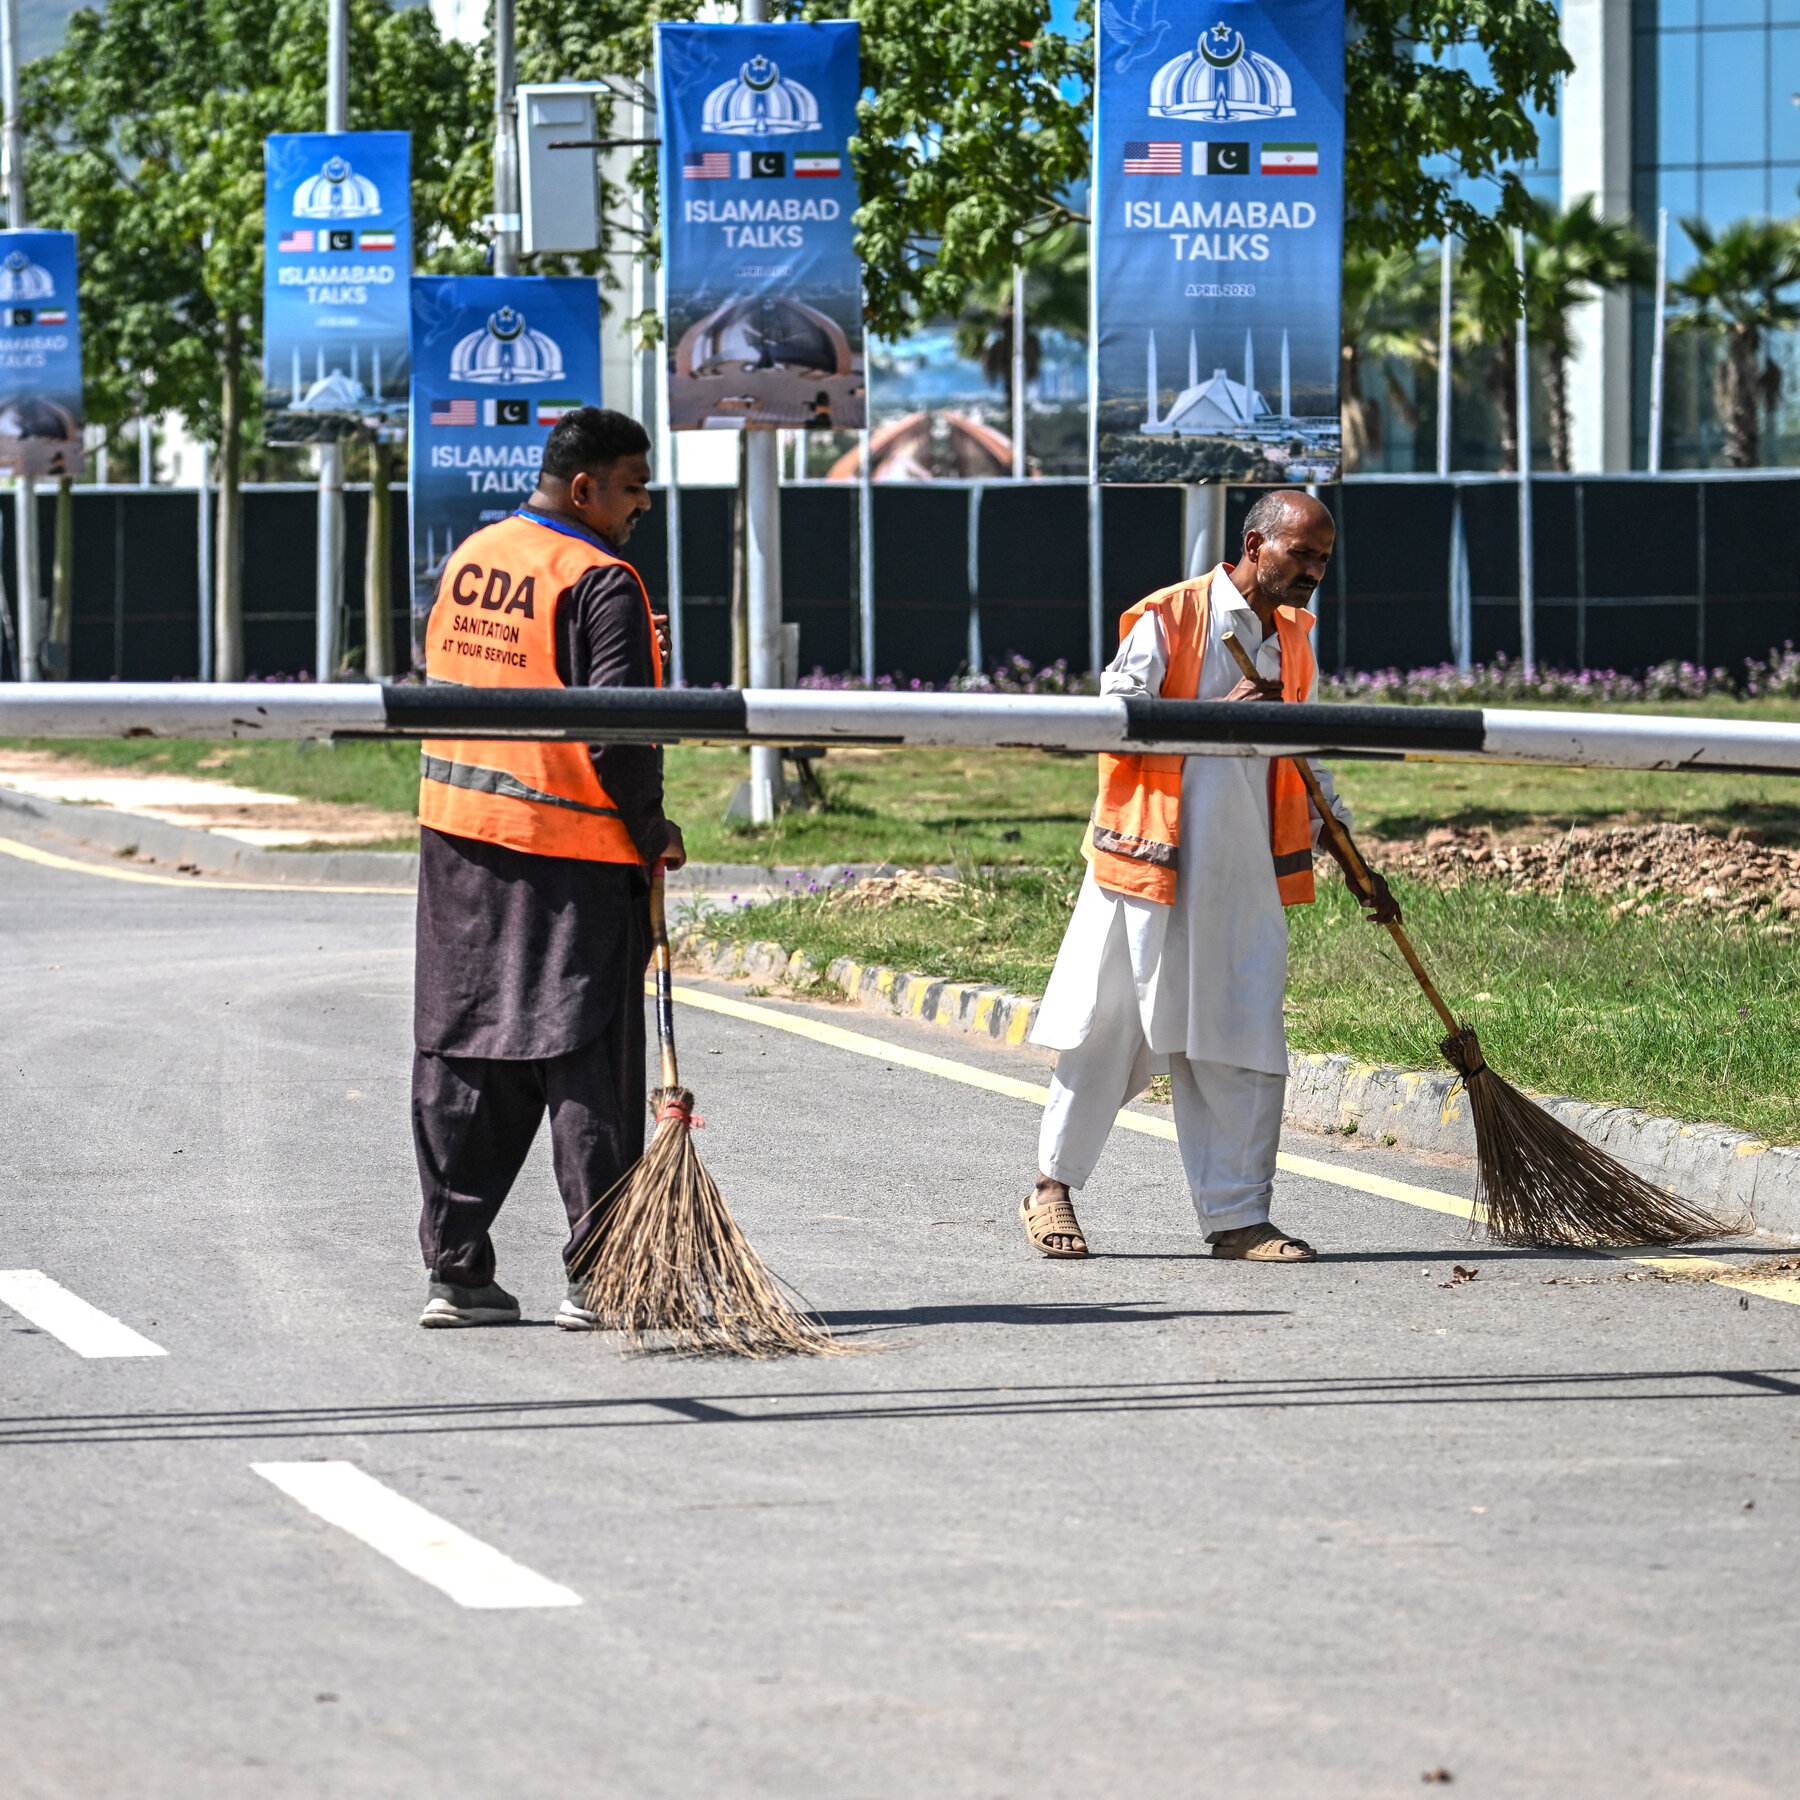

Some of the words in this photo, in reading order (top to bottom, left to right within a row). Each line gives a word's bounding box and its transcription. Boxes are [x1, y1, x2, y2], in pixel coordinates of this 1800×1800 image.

[685, 199, 840, 223] ISLAMABAD
[1125, 201, 1316, 228] ISLAMABAD
[721, 225, 803, 248] TALKS
[1169, 233, 1270, 261] TALKS
[278, 265, 395, 285] ISLAMABAD
[306, 285, 368, 305] TALKS
[1184, 283, 1220, 297] APRIL
[1222, 283, 1256, 297] 2026
[452, 563, 535, 620] CDA
[453, 614, 520, 643] SANITATION
[441, 638, 454, 653] AT
[457, 641, 483, 658] YOUR
[484, 646, 527, 668] SERVICE
